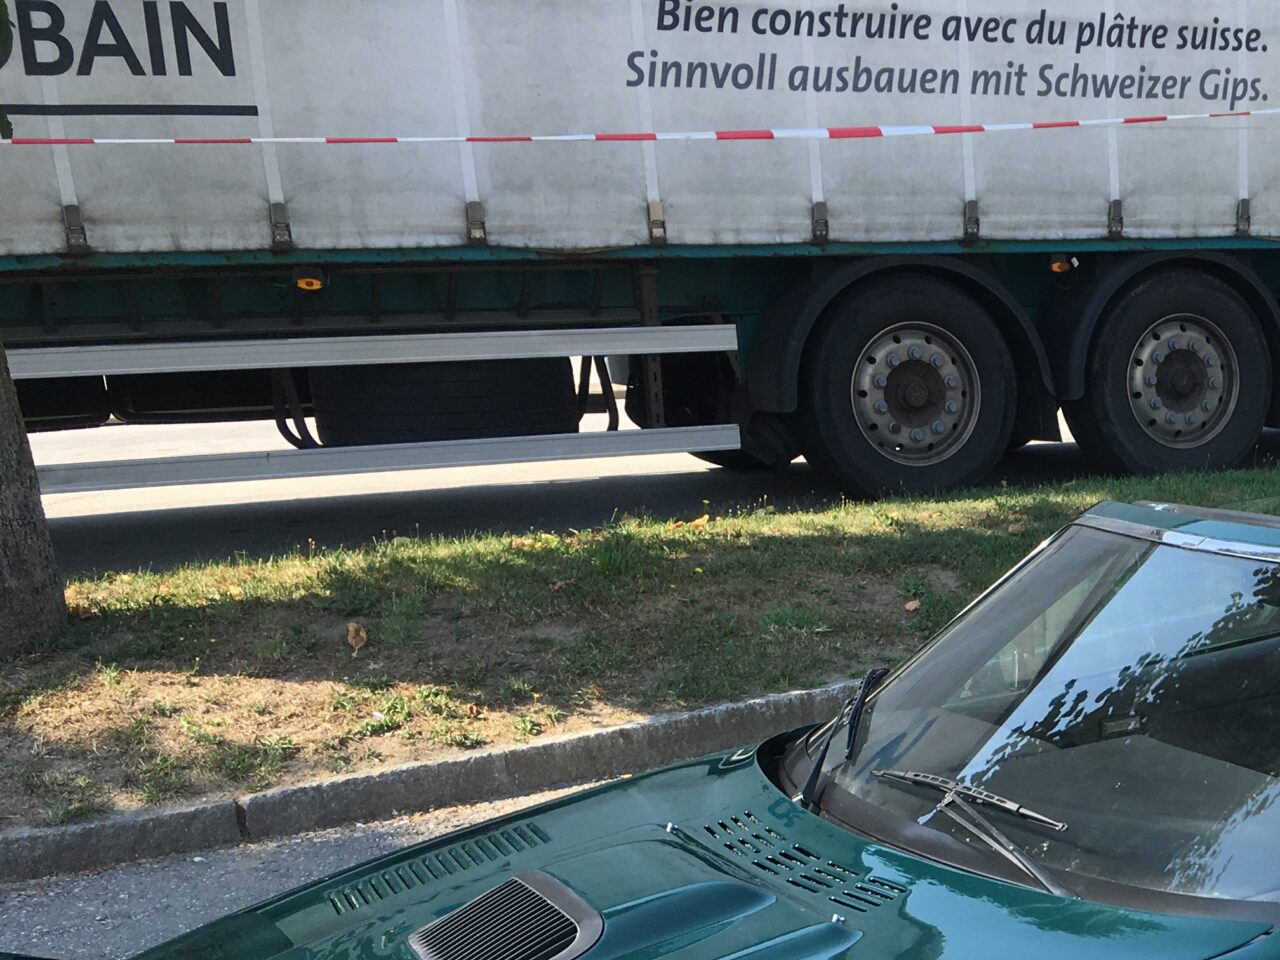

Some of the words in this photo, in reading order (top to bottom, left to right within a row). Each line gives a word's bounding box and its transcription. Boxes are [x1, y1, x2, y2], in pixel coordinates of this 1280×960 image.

[656, 0, 739, 33] Bien
[751, 2, 932, 40] construire
[941, 15, 1017, 44] avec
[1025, 9, 1066, 46] du
[1075, 11, 1168, 54] plâtre
[1176, 17, 1268, 53] suisse.
[625, 49, 777, 90] Sinnvoll
[787, 55, 960, 94] ausbauen
[970, 61, 1027, 96] mit
[1036, 62, 1191, 99] Schweizer
[1199, 67, 1269, 111] Gips.
